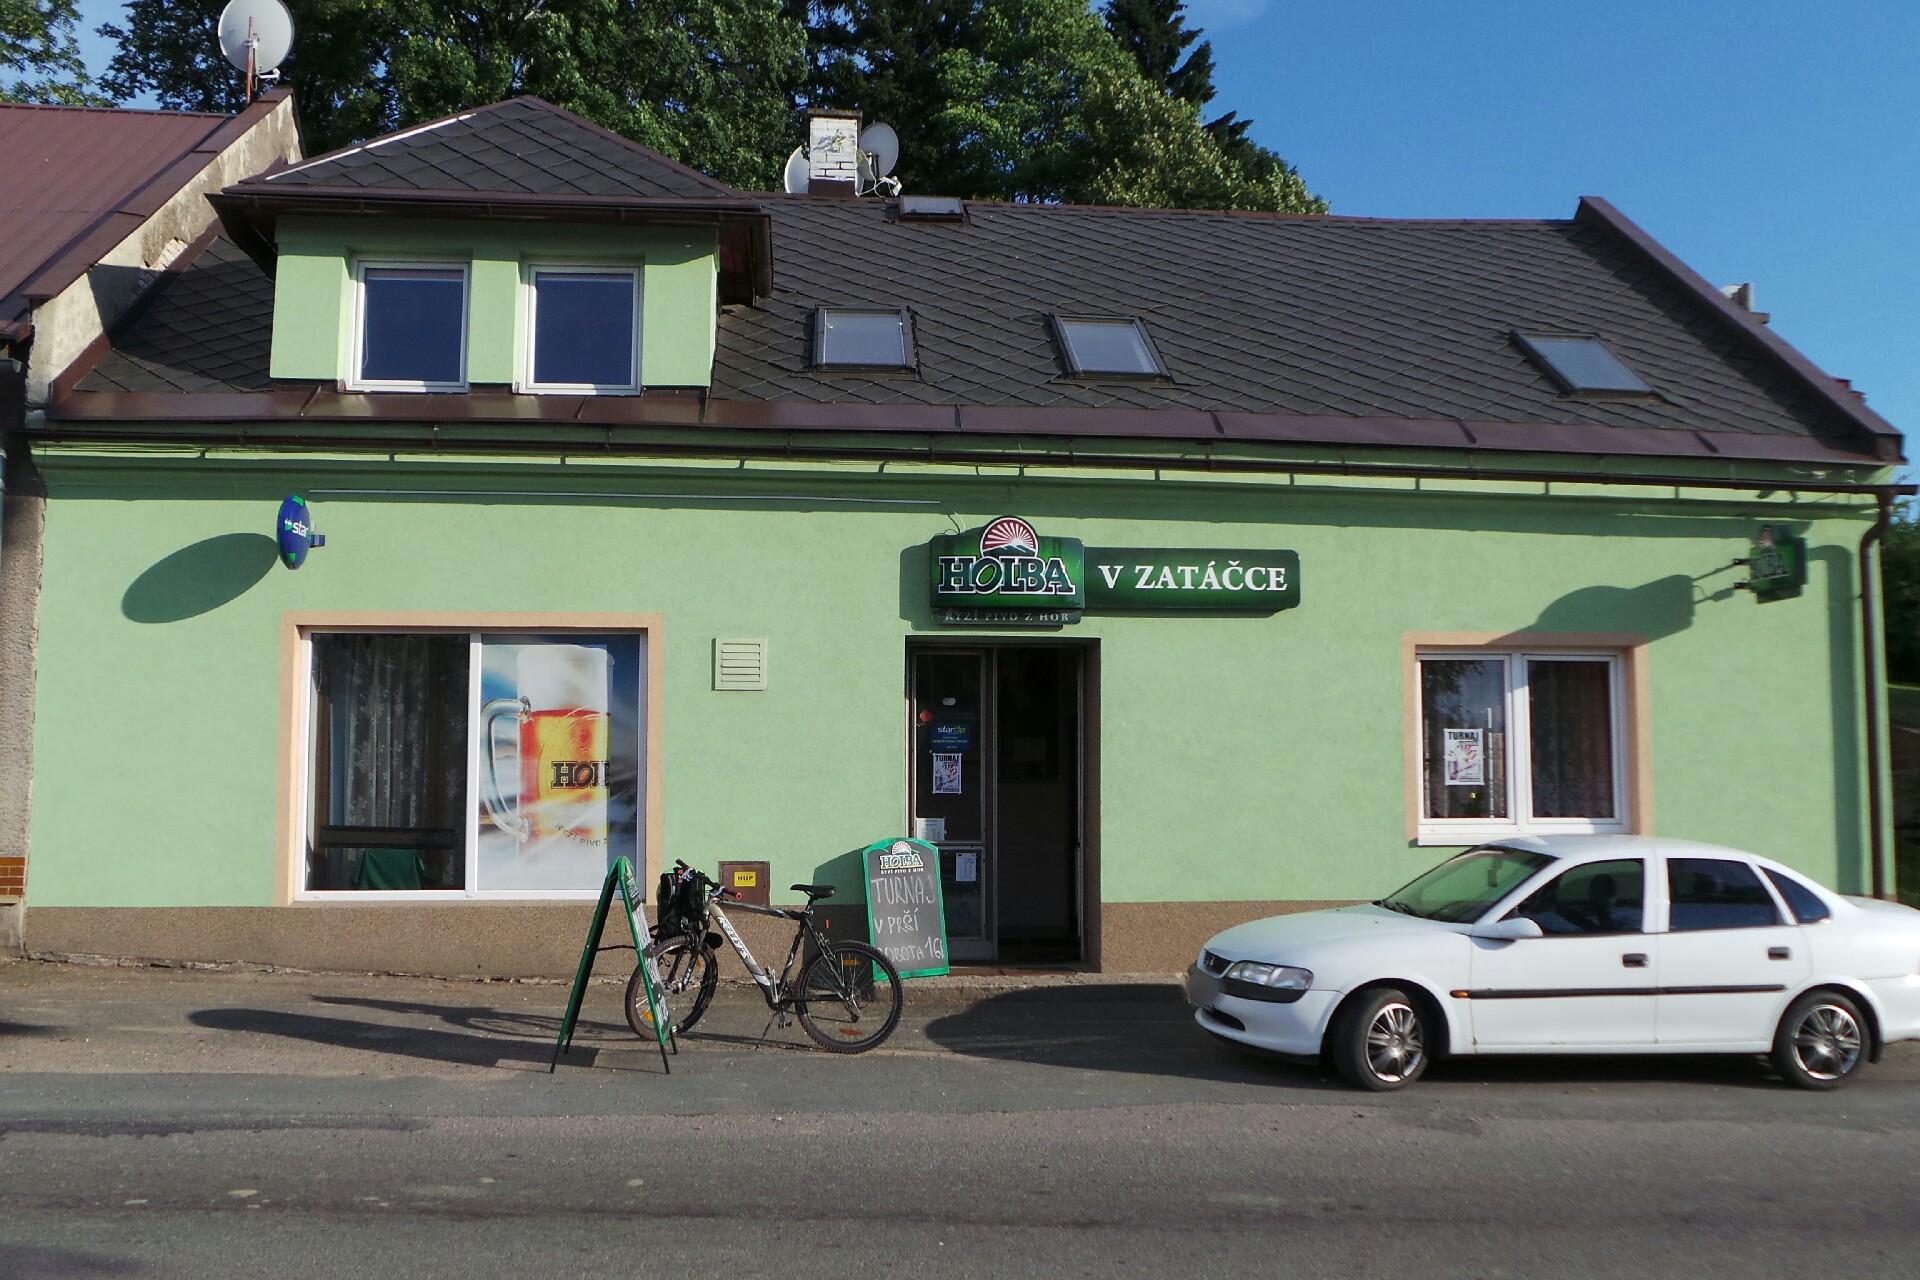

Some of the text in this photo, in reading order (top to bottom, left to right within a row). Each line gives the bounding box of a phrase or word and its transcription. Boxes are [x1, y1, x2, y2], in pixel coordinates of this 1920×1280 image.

[938, 556, 1076, 595] HOLBA
[1098, 559, 1288, 592] V ZATÁČCE
[1039, 612, 1070, 622] HOR
[1448, 731, 1479, 742] TURNAJ
[879, 853, 923, 869] HOLBA
[871, 875, 935, 904] TURNAJ
[873, 917, 884, 935] V
[878, 945, 924, 962] OBOTA
